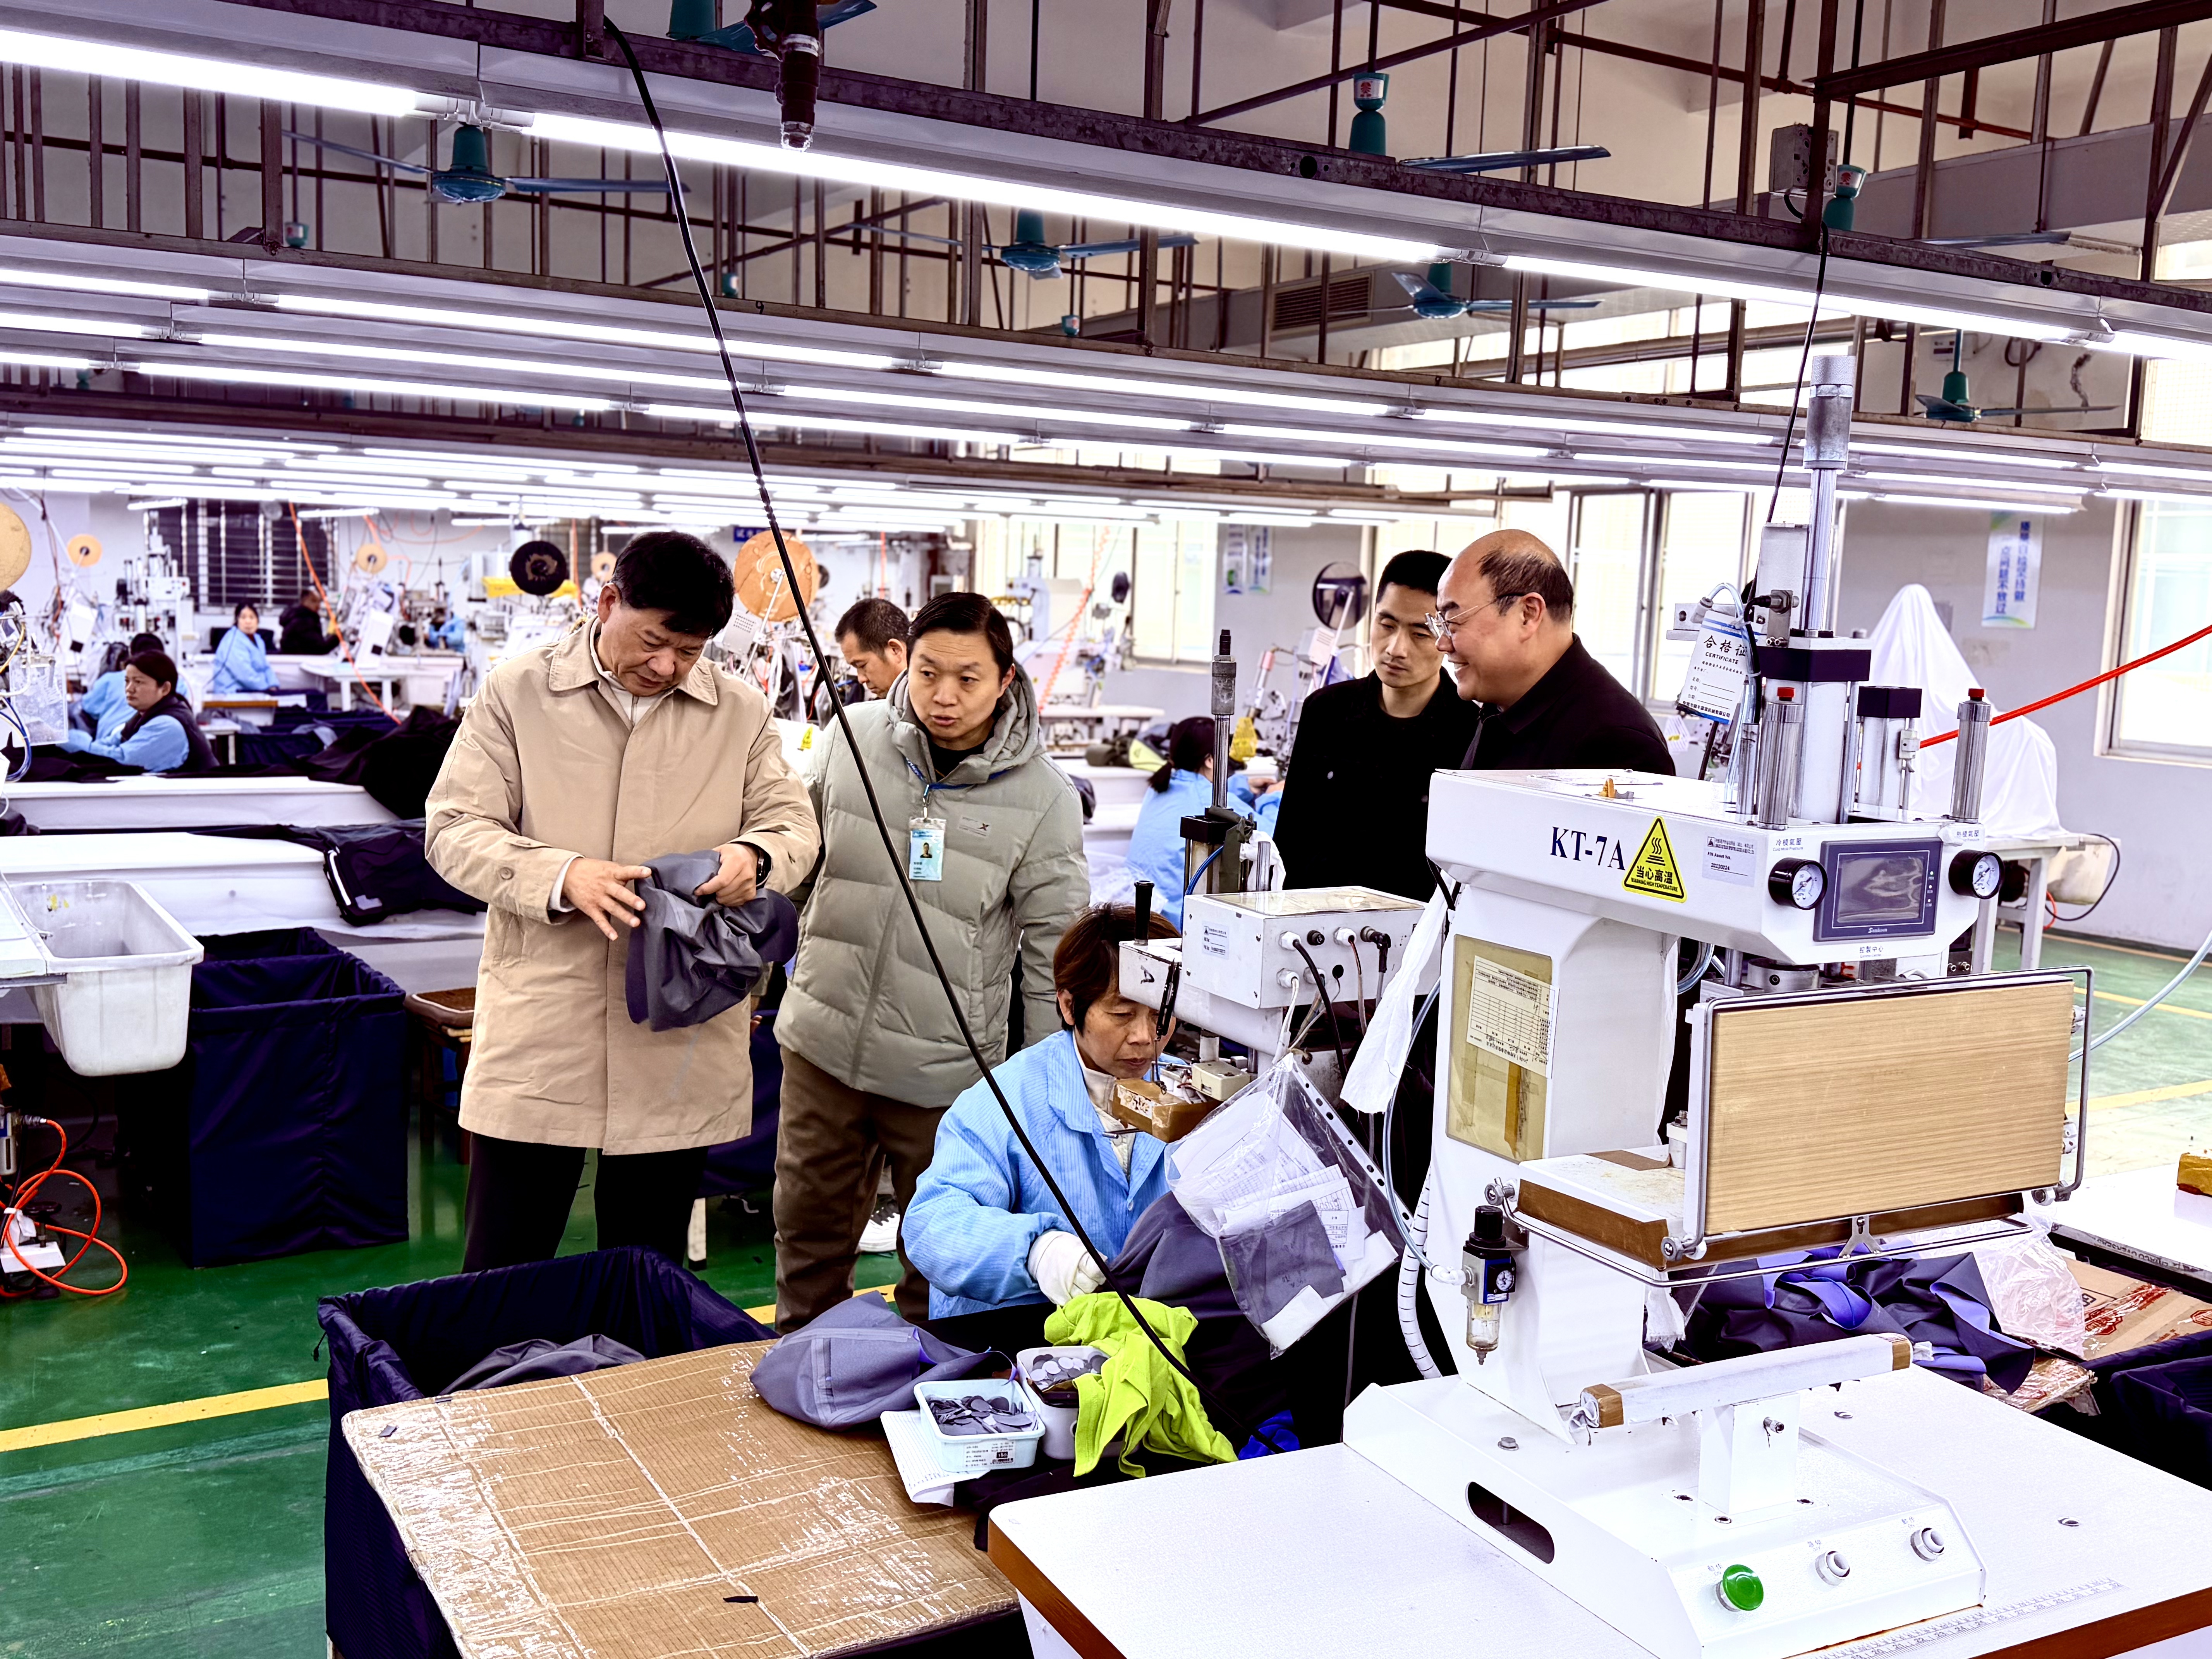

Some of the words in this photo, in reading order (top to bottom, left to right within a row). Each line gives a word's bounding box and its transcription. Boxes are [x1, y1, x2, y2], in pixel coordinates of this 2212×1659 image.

[1704, 635, 1747, 656] 合格证
[1705, 652, 1739, 664] CERTIFICATE
[1550, 826, 1625, 871] KT-7A
[1636, 866, 1673, 884] 当心高温
